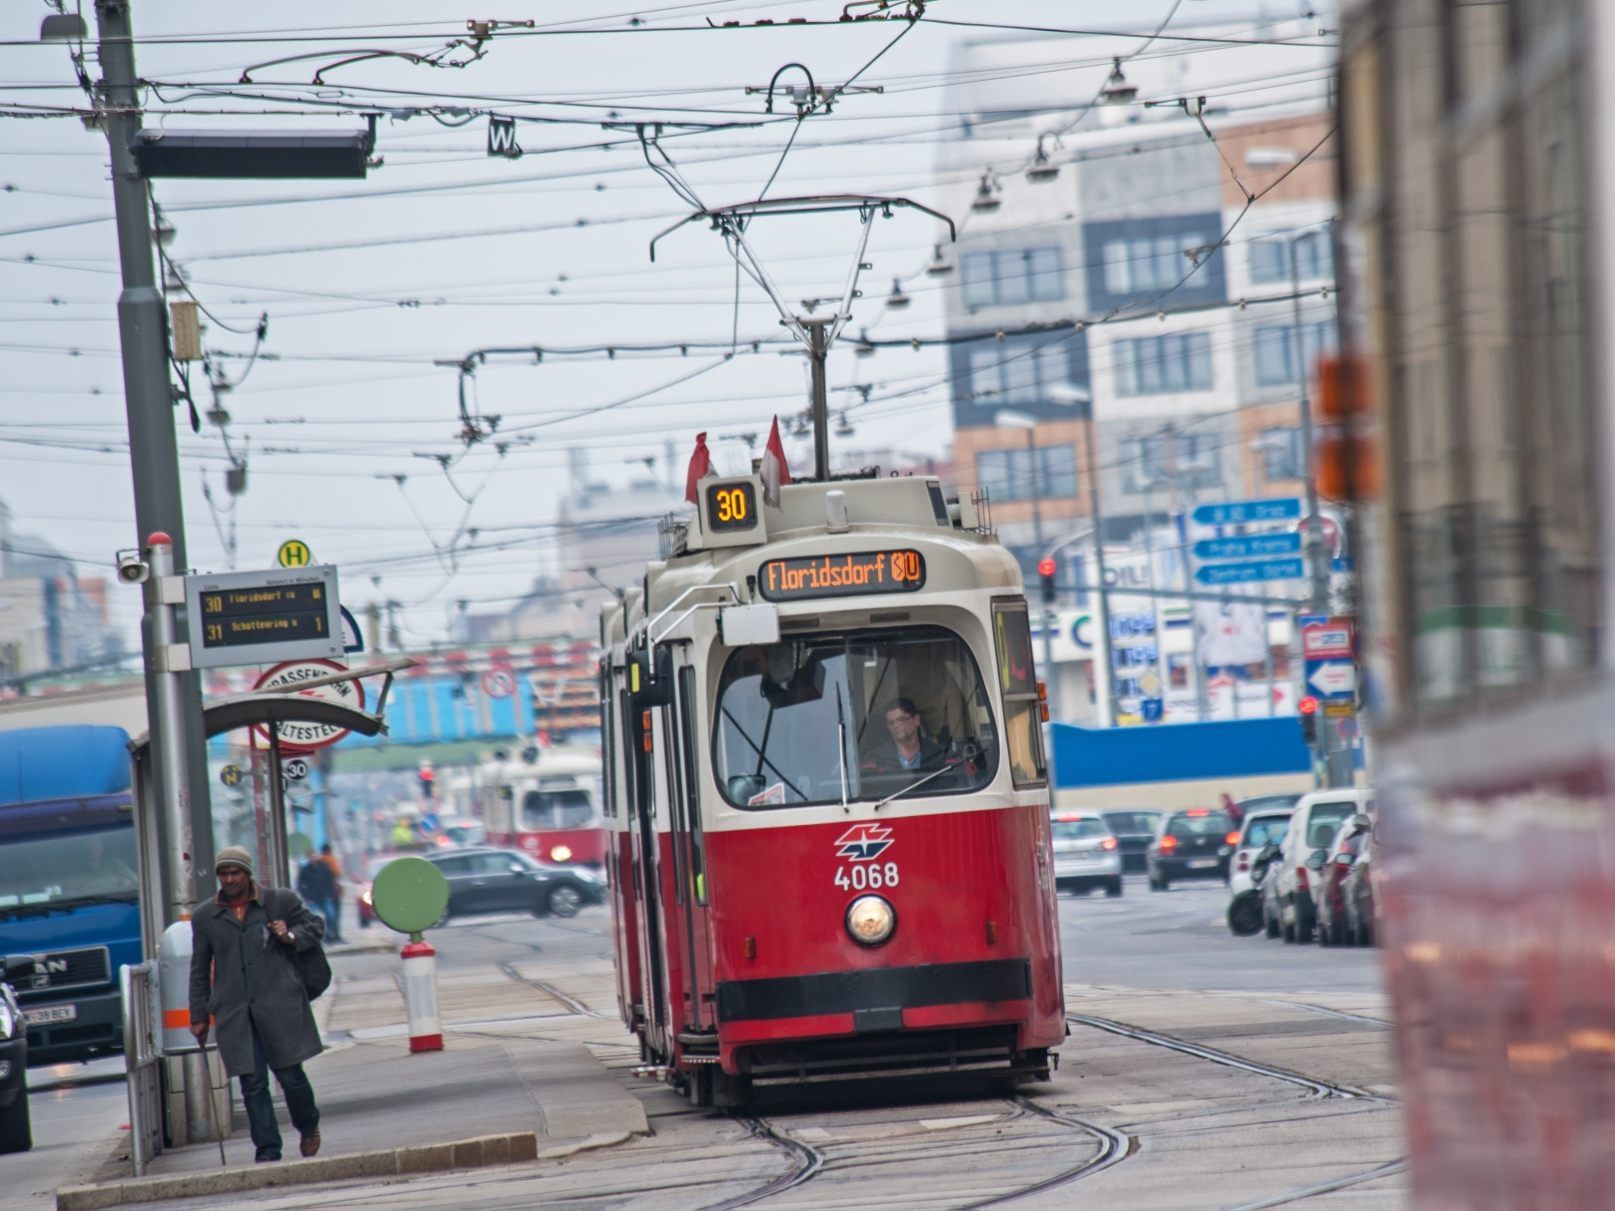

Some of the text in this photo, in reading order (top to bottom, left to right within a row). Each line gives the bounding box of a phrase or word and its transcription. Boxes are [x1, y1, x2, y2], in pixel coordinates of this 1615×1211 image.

[490, 125, 514, 151] W
[717, 489, 746, 521] 30
[286, 546, 302, 565] H
[768, 552, 885, 591] Floridsdorf
[205, 596, 223, 613] 30
[207, 623, 223, 641] 31
[315, 616, 322, 633] 1
[287, 764, 307, 777] 30
[834, 862, 899, 891] 4068
[34, 960, 67, 973] AN
